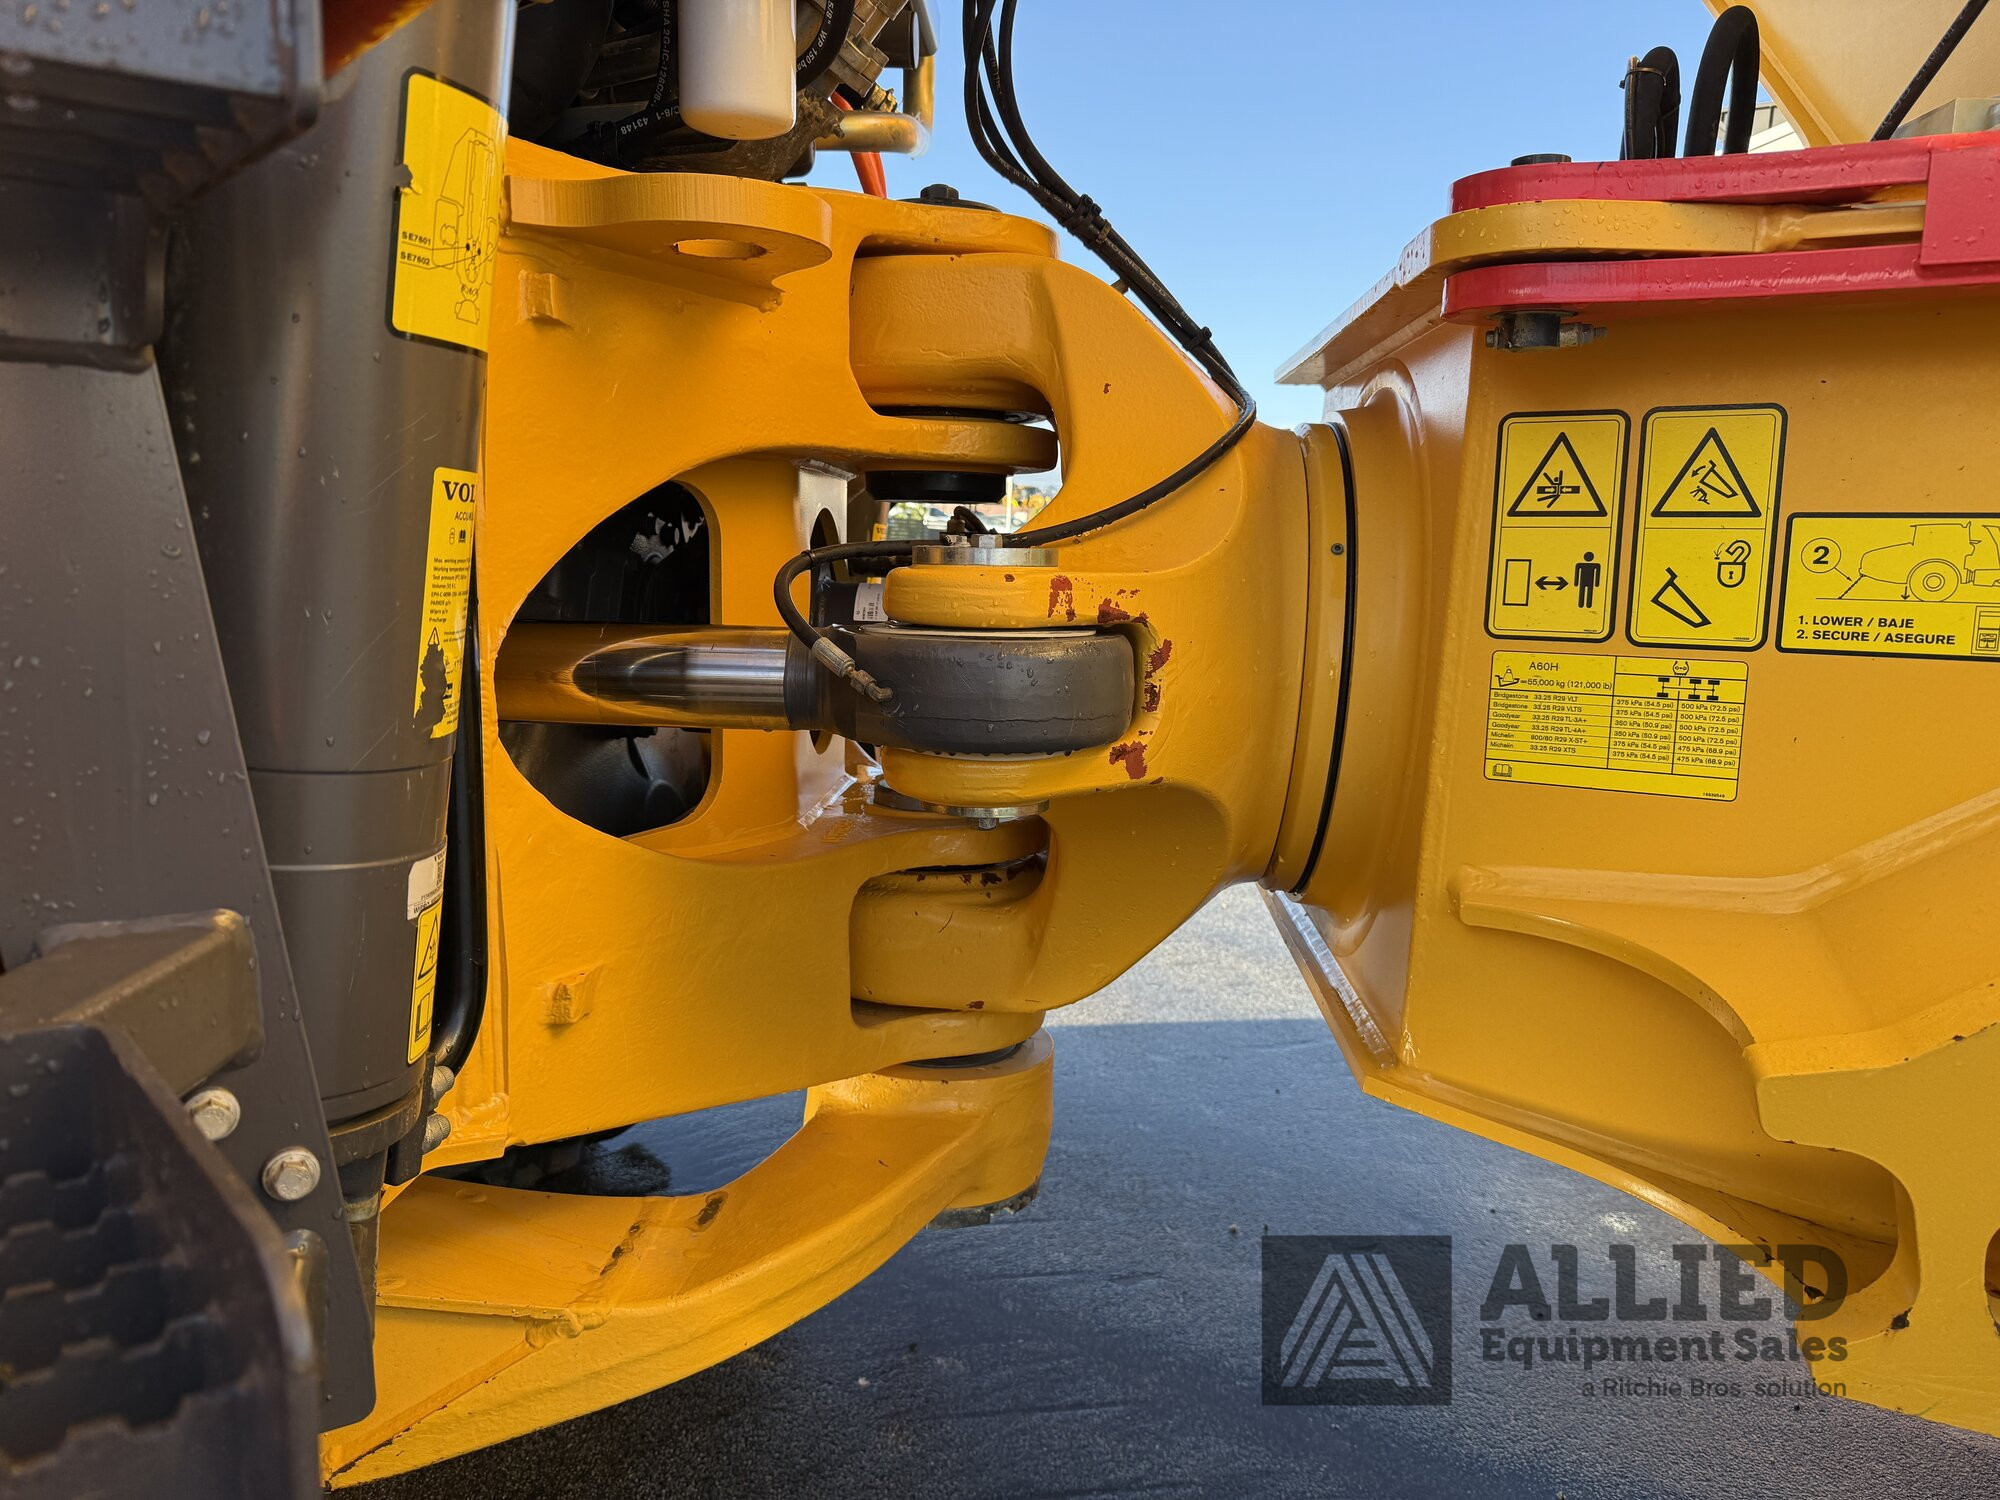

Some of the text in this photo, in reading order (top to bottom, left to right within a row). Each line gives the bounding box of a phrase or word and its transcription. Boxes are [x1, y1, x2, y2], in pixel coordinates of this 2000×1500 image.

[817, 30, 828, 48] WP
[805, 48, 818, 64] 150
[620, 116, 649, 135] 43148
[1812, 545, 1830, 565] 2
[1798, 615, 1915, 629] 1. LOWER / BAJE
[1796, 629, 1956, 645] 2. SECURE / ASEGURE
[1528, 661, 1559, 671] A60H
[1555, 680, 1566, 689] kg
[1567, 680, 1601, 689] (121,000
[1602, 680, 1613, 690] lb)
[1493, 691, 1529, 699] Bridgestone
[1492, 701, 1528, 709] Bridgestone
[1566, 705, 1583, 713] VLTS
[1728, 705, 1741, 713] psi)
[1492, 711, 1521, 719] Goodyear
[1629, 709, 1642, 717] kPa
[1491, 721, 1520, 729] Goodyear
[1727, 716, 1740, 724] psi)
[1628, 730, 1640, 738] kPa
